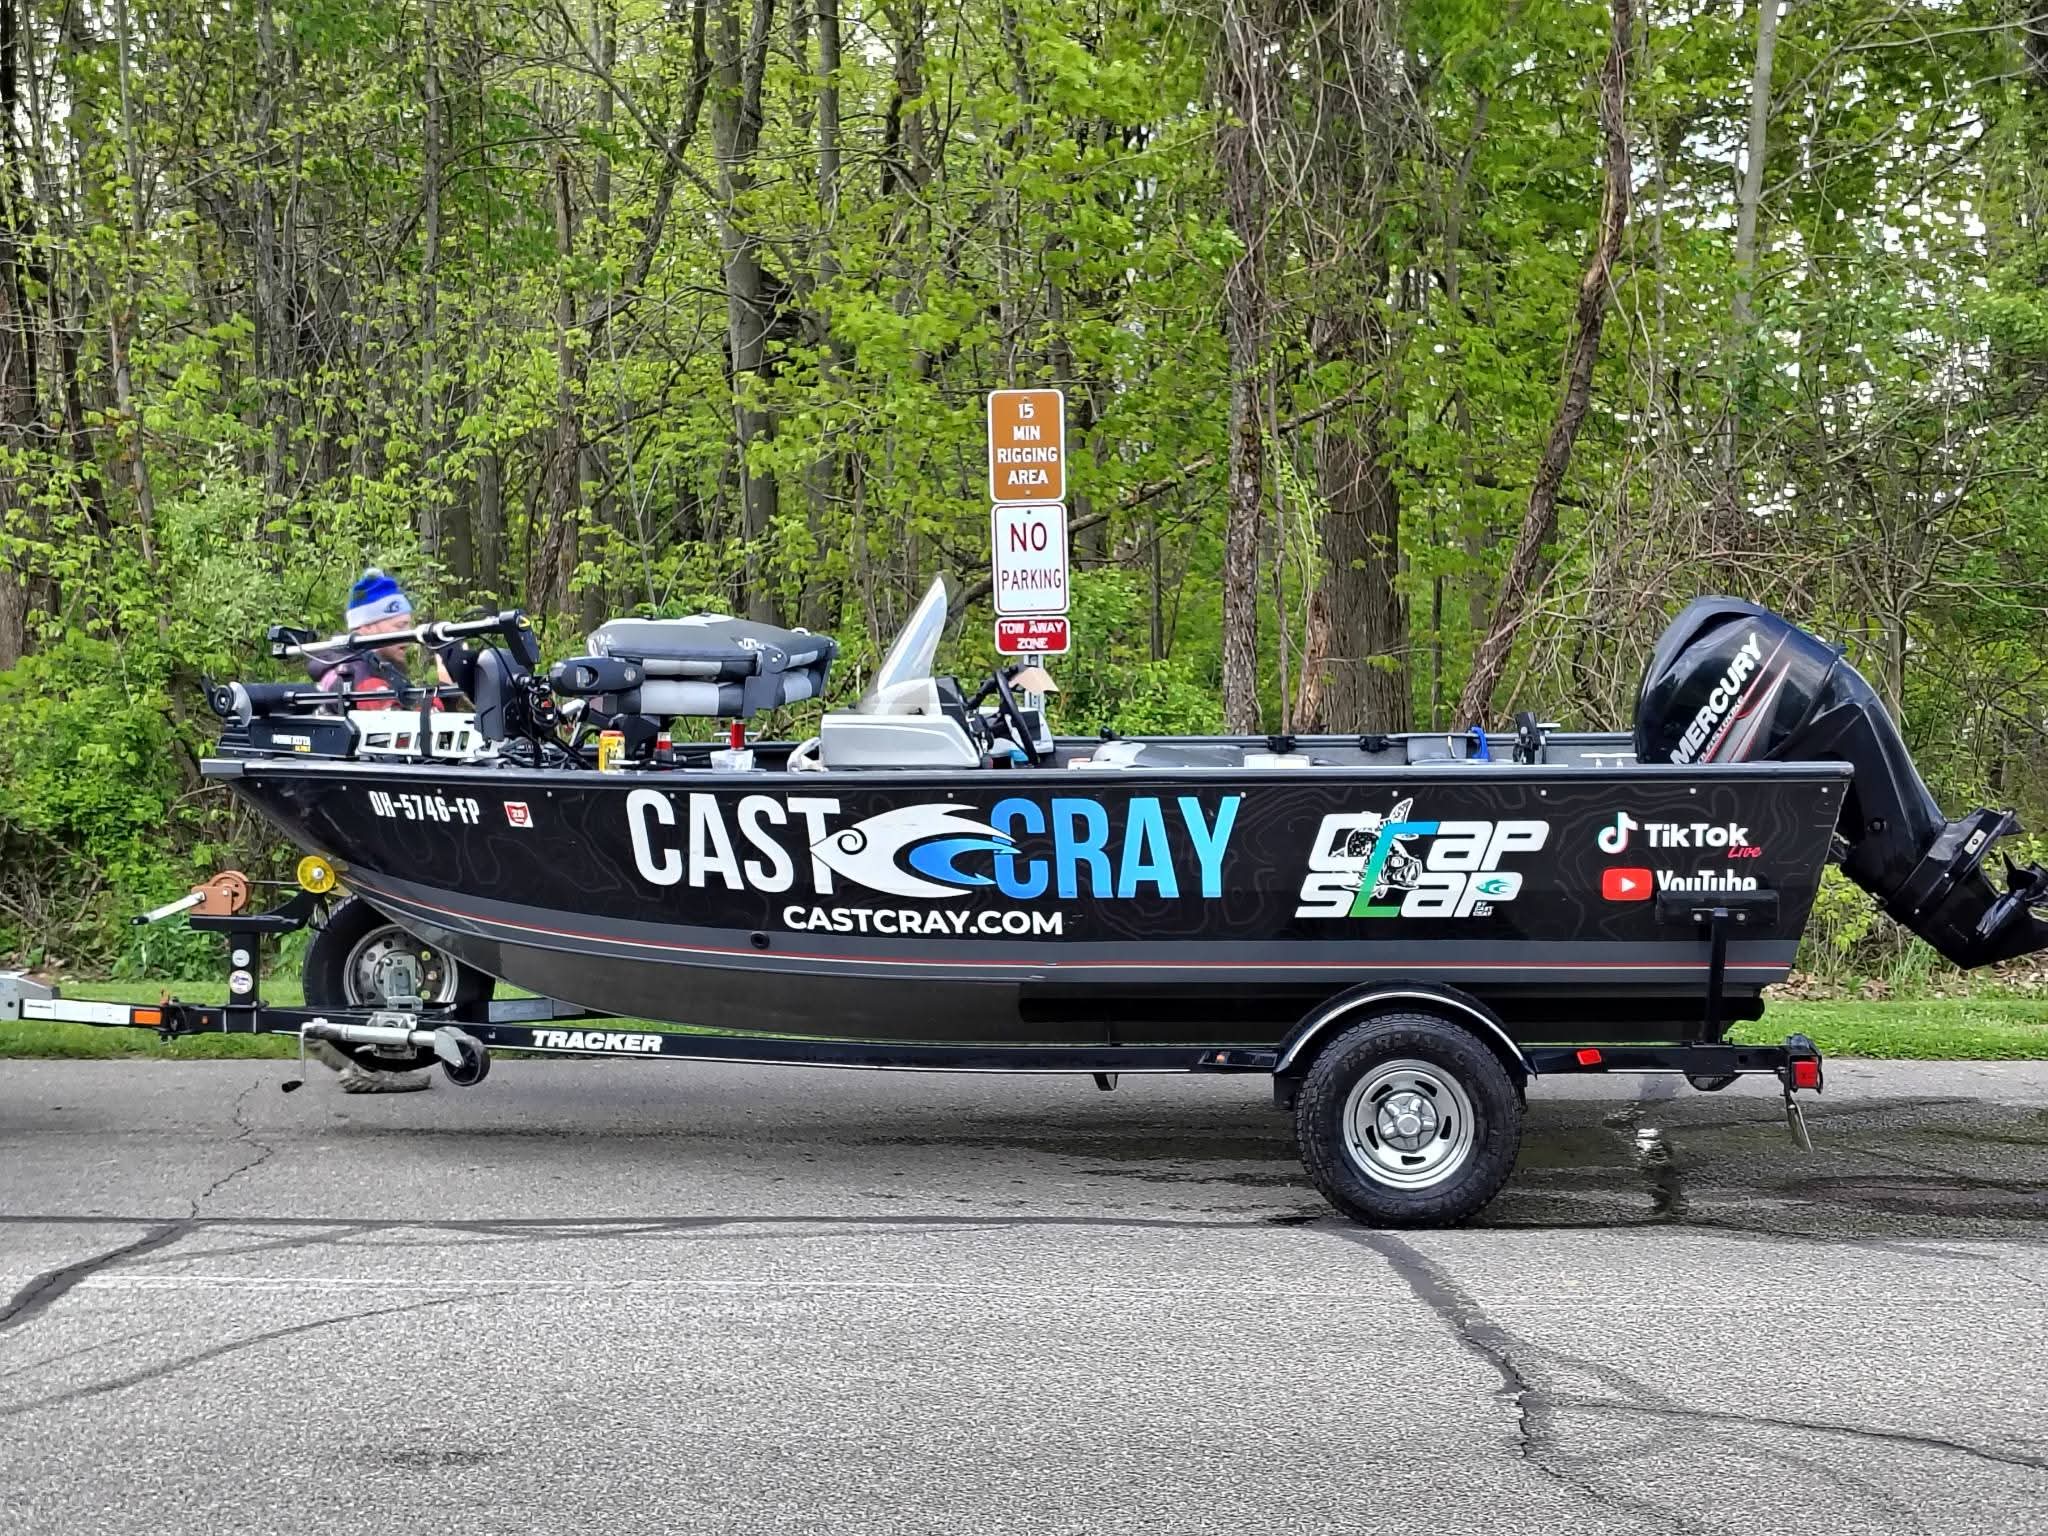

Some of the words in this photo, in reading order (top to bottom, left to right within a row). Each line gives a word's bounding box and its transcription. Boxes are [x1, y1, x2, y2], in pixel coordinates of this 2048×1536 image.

[1018, 403, 1035, 419] 15
[1013, 426, 1040, 441] MIN
[997, 447, 1058, 463] RIGGING
[1008, 469, 1049, 485] AREA
[1010, 522, 1047, 552] NO
[1001, 568, 1061, 590] PARKING
[1000, 622, 1025, 635] TOW
[1029, 621, 1064, 634] AWAY
[1017, 637, 1049, 650] ZONE
[1669, 632, 1761, 765] MERCURY
[368, 790, 480, 824] OH-5746-FP
[625, 788, 841, 895] CAST
[1644, 822, 1750, 848] TikTok
[990, 796, 1241, 899] CRAY
[783, 905, 1063, 936] CASTCRAY.COM
[532, 1029, 664, 1052] TRACKER
